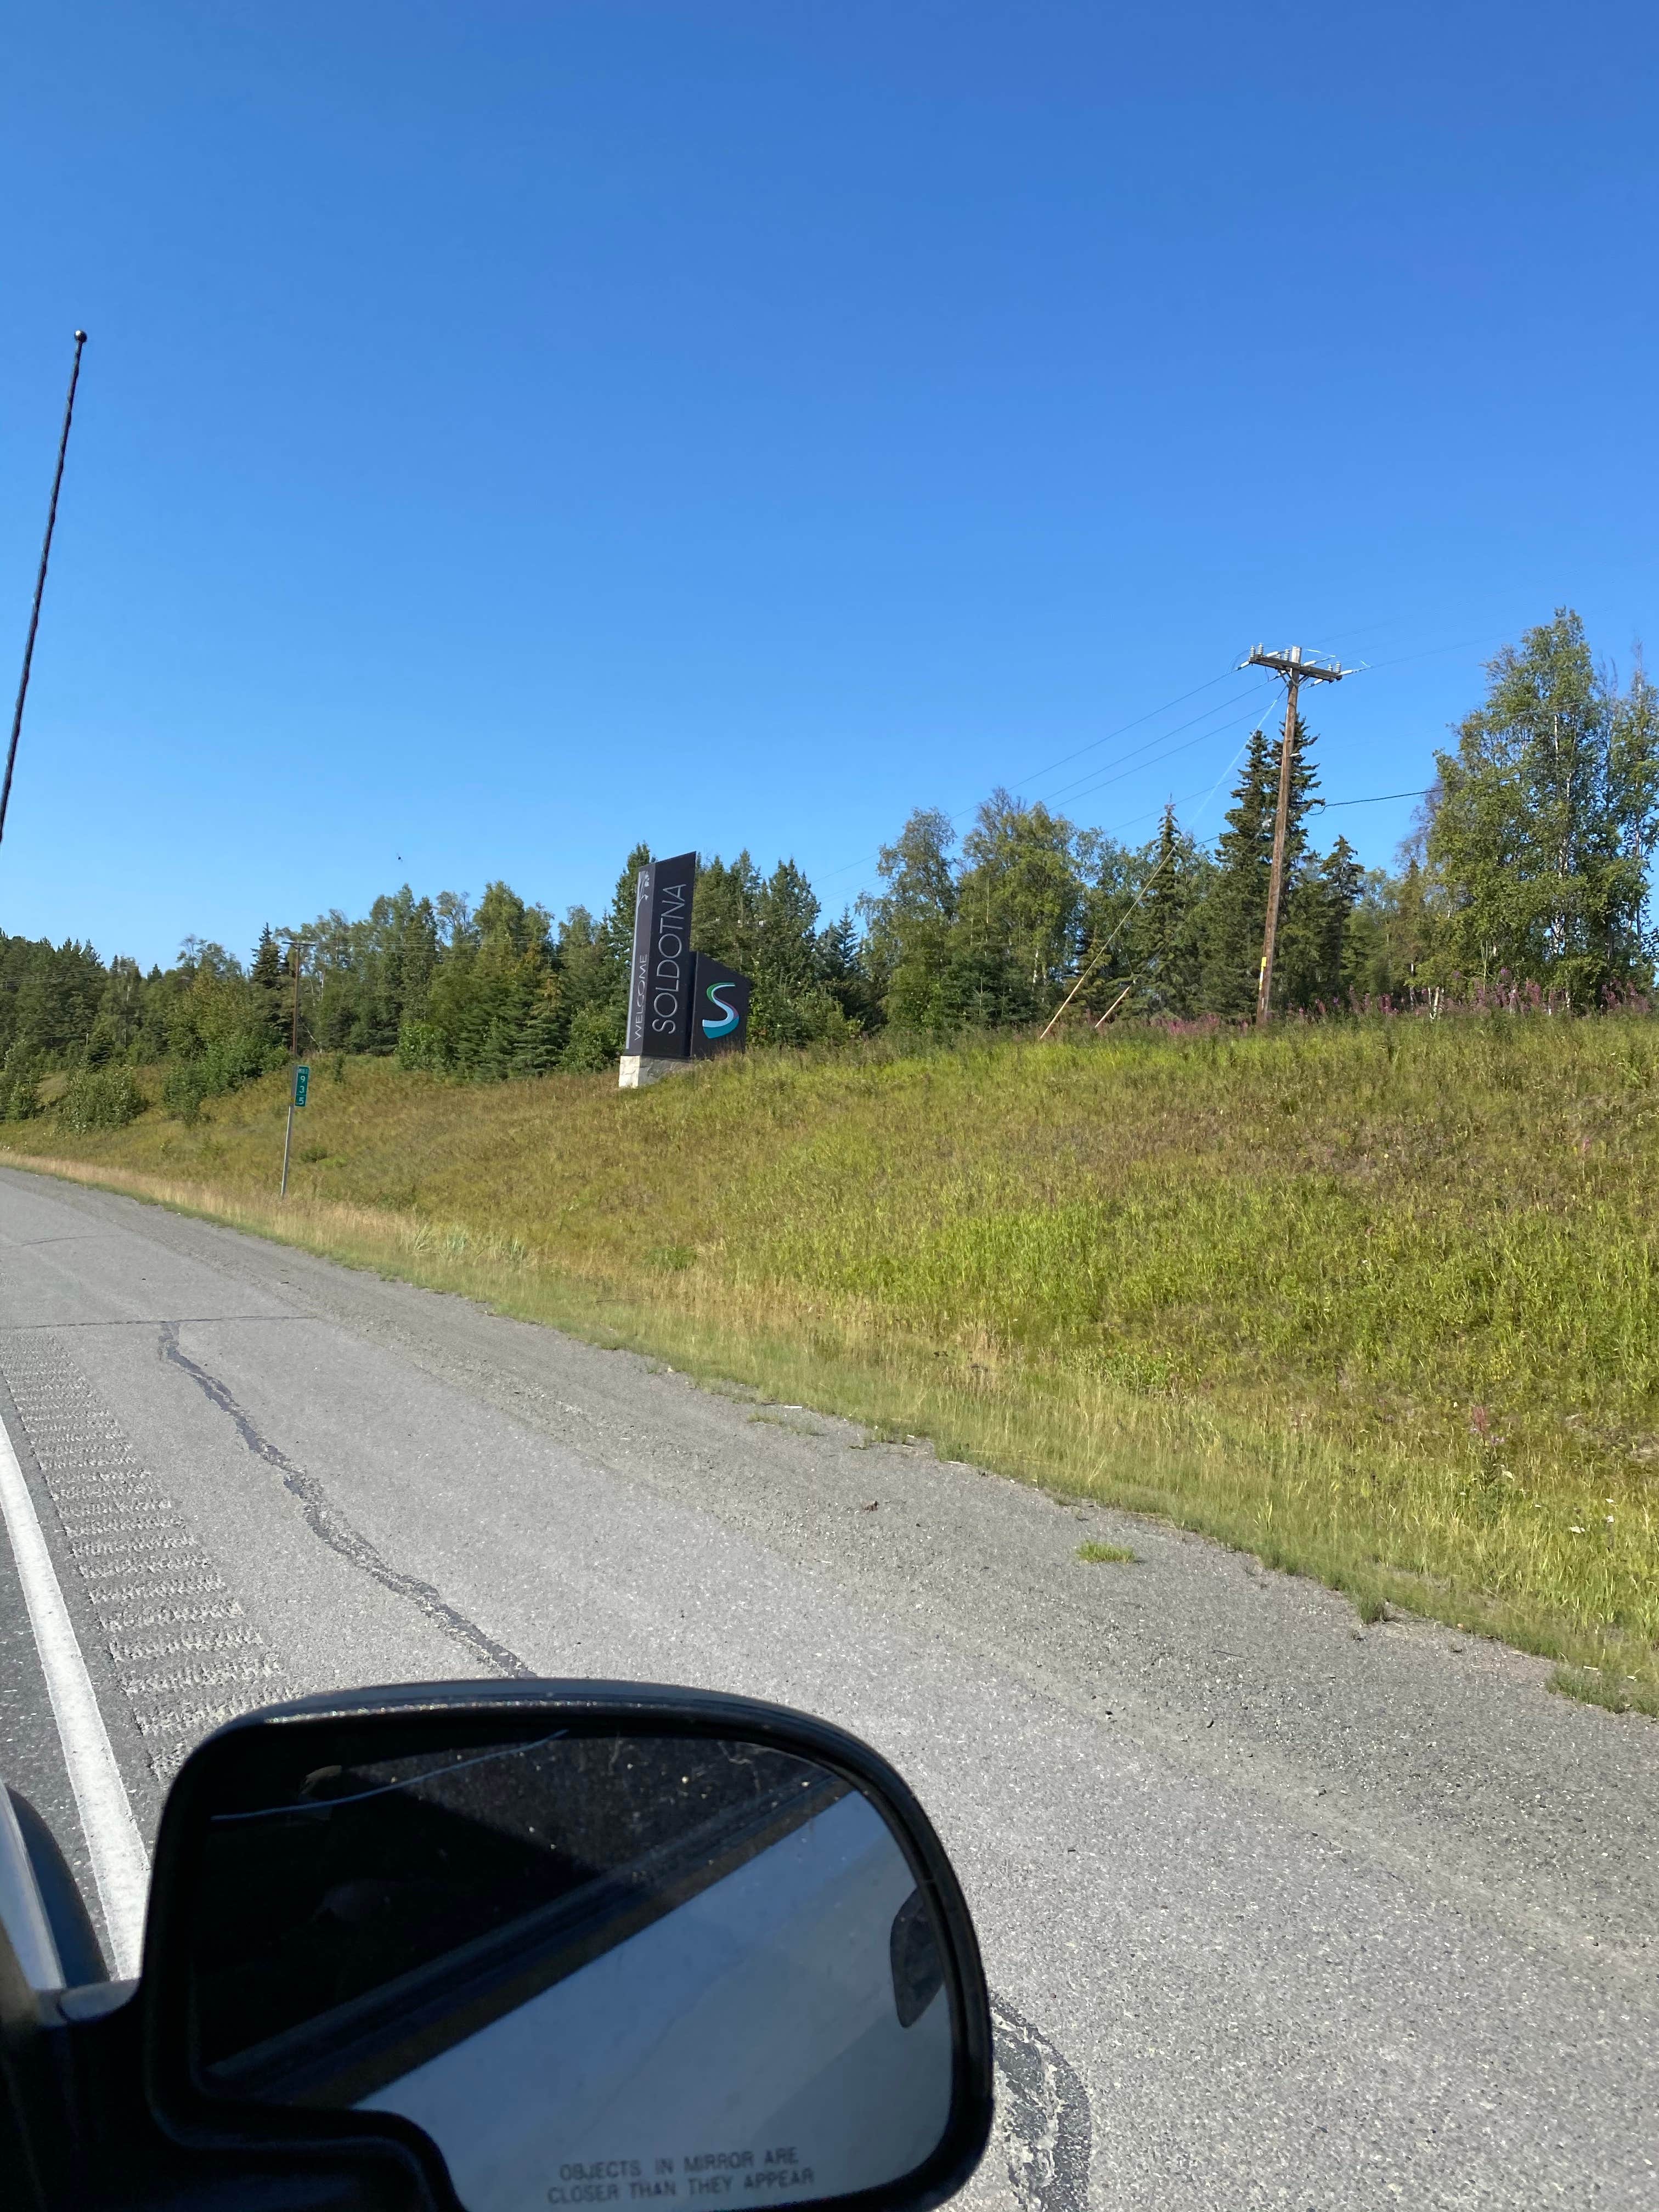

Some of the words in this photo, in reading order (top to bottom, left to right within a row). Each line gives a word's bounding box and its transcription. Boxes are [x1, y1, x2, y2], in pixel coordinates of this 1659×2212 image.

[652, 883, 686, 1034] SOLDOTNA
[634, 955, 647, 1041] WELCOME
[548, 2183, 619, 2204] CLOSER
[630, 2181, 676, 2199] THAN
[688, 2175, 732, 2196] THEY
[743, 2167, 815, 2188] APPEAR
[559, 2159, 641, 2181] OBJECTS
[655, 2158, 673, 2175] IN
[684, 2151, 754, 2174] MIRROR
[764, 2147, 799, 2165] ARE
